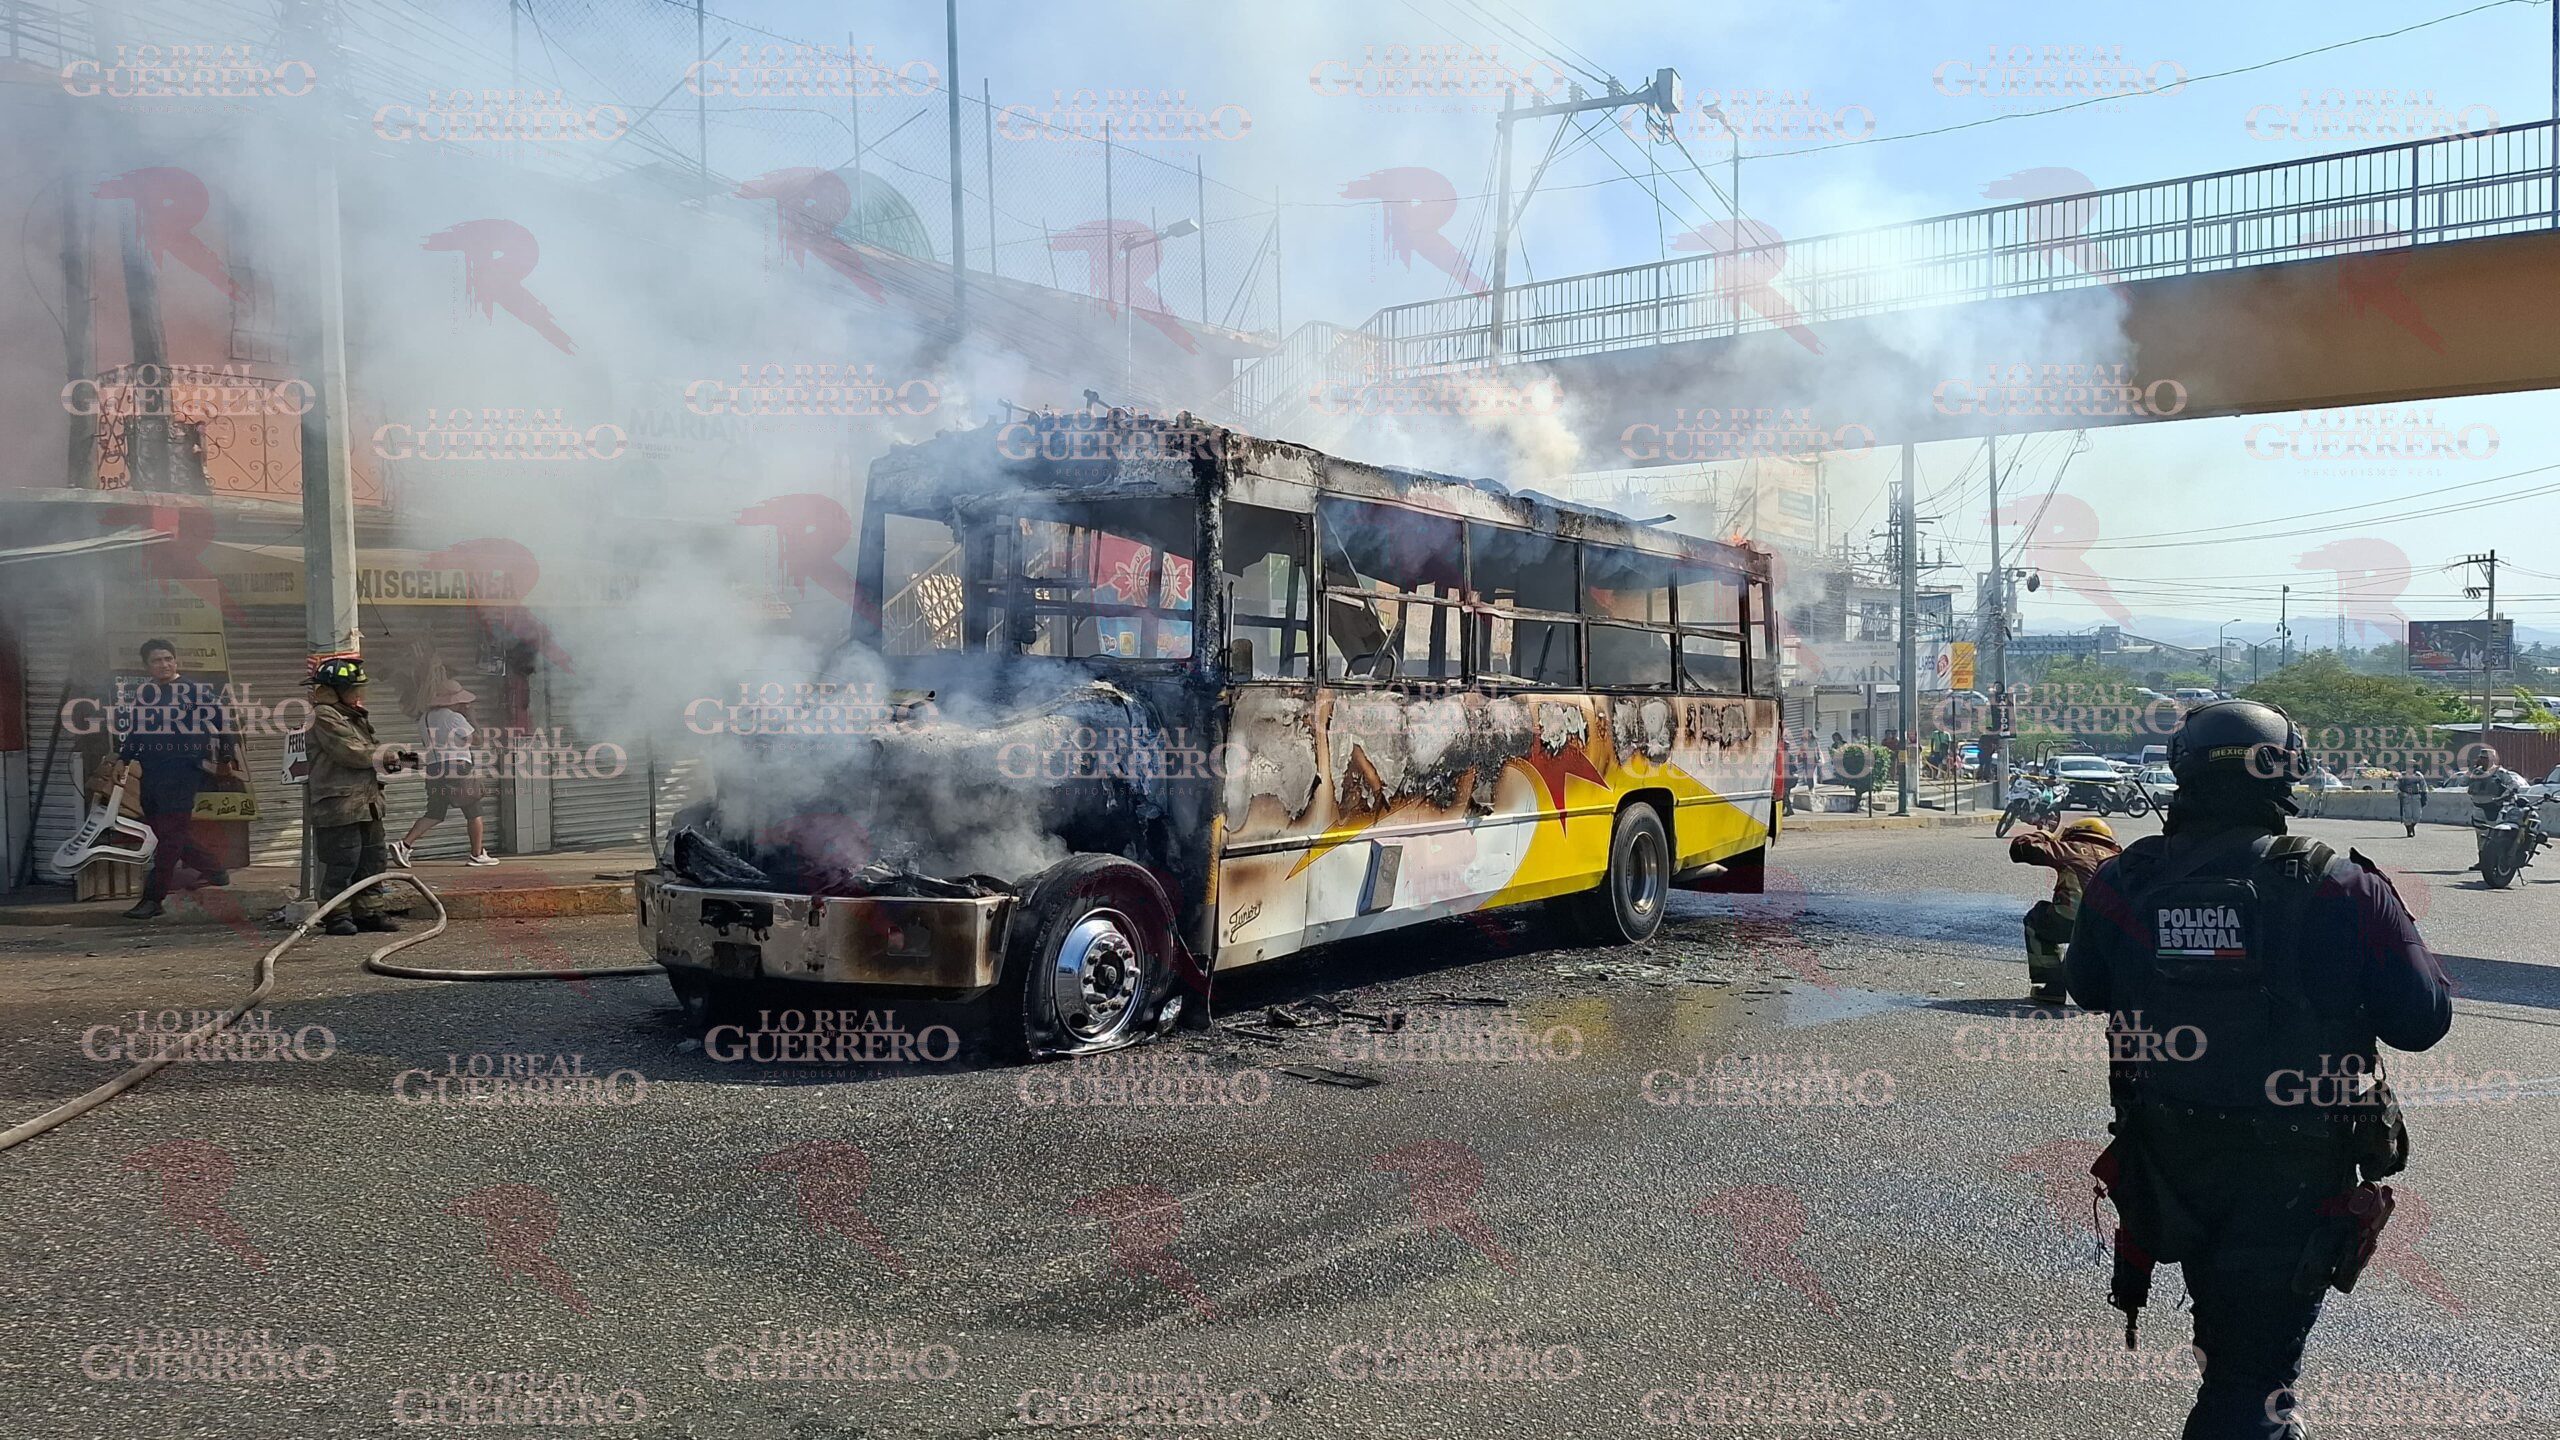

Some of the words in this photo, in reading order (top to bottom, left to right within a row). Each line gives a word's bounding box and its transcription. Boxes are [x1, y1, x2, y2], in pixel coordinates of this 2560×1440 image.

[357, 569, 516, 599] MISCELANEA
[2158, 905, 2240, 928] POLICÍA
[2159, 928, 2243, 949] ESTATAL
